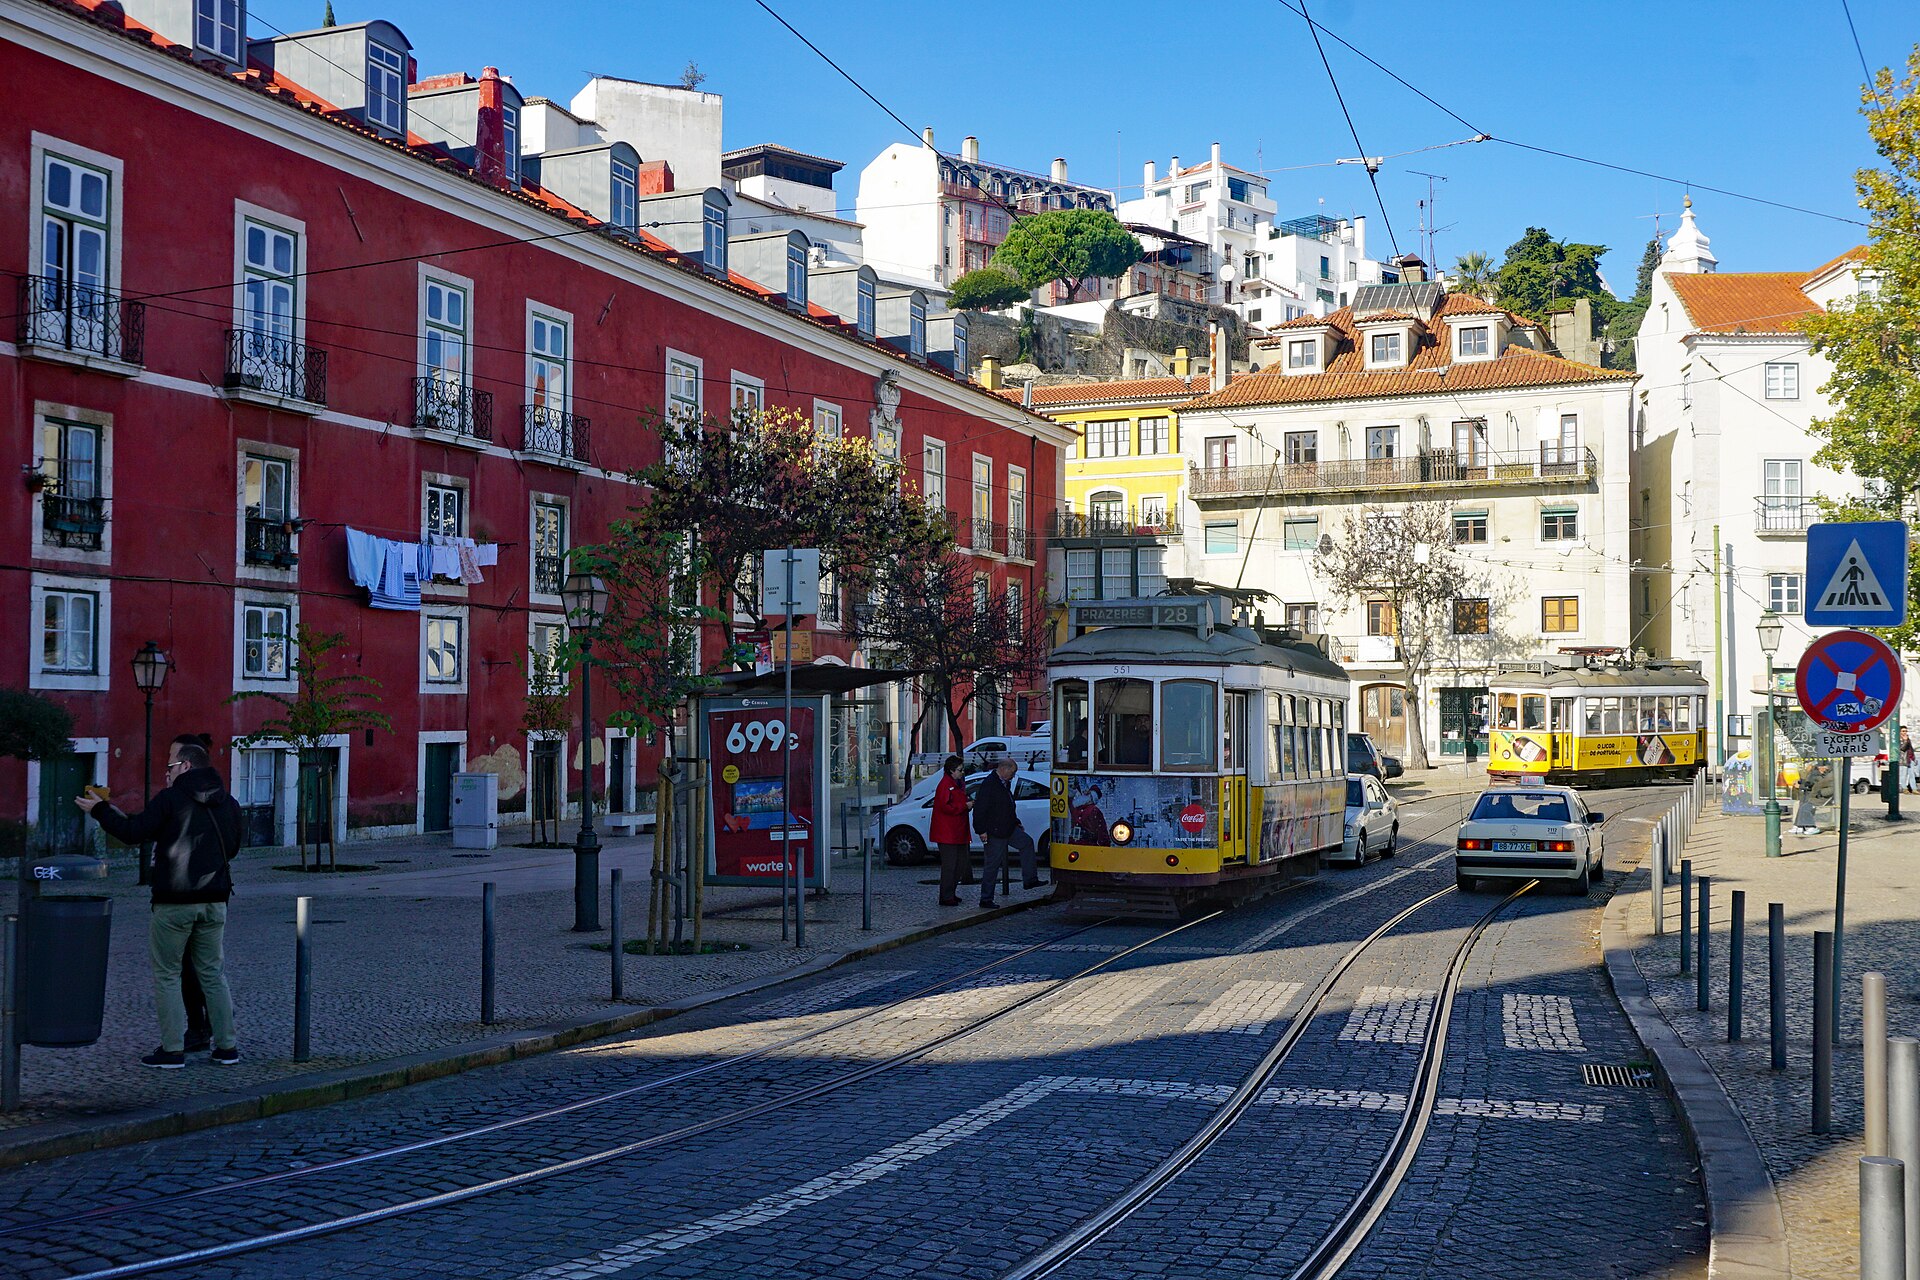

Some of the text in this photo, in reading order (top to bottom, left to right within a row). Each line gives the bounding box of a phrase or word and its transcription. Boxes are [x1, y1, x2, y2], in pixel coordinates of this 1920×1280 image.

[1081, 607, 1188, 623] PRAZERES 28
[1113, 665, 1130, 674] 551
[1823, 734, 1871, 744] EXCEPTO
[1828, 745, 1868, 754] CARRIS
[33, 866, 63, 880] GBK
